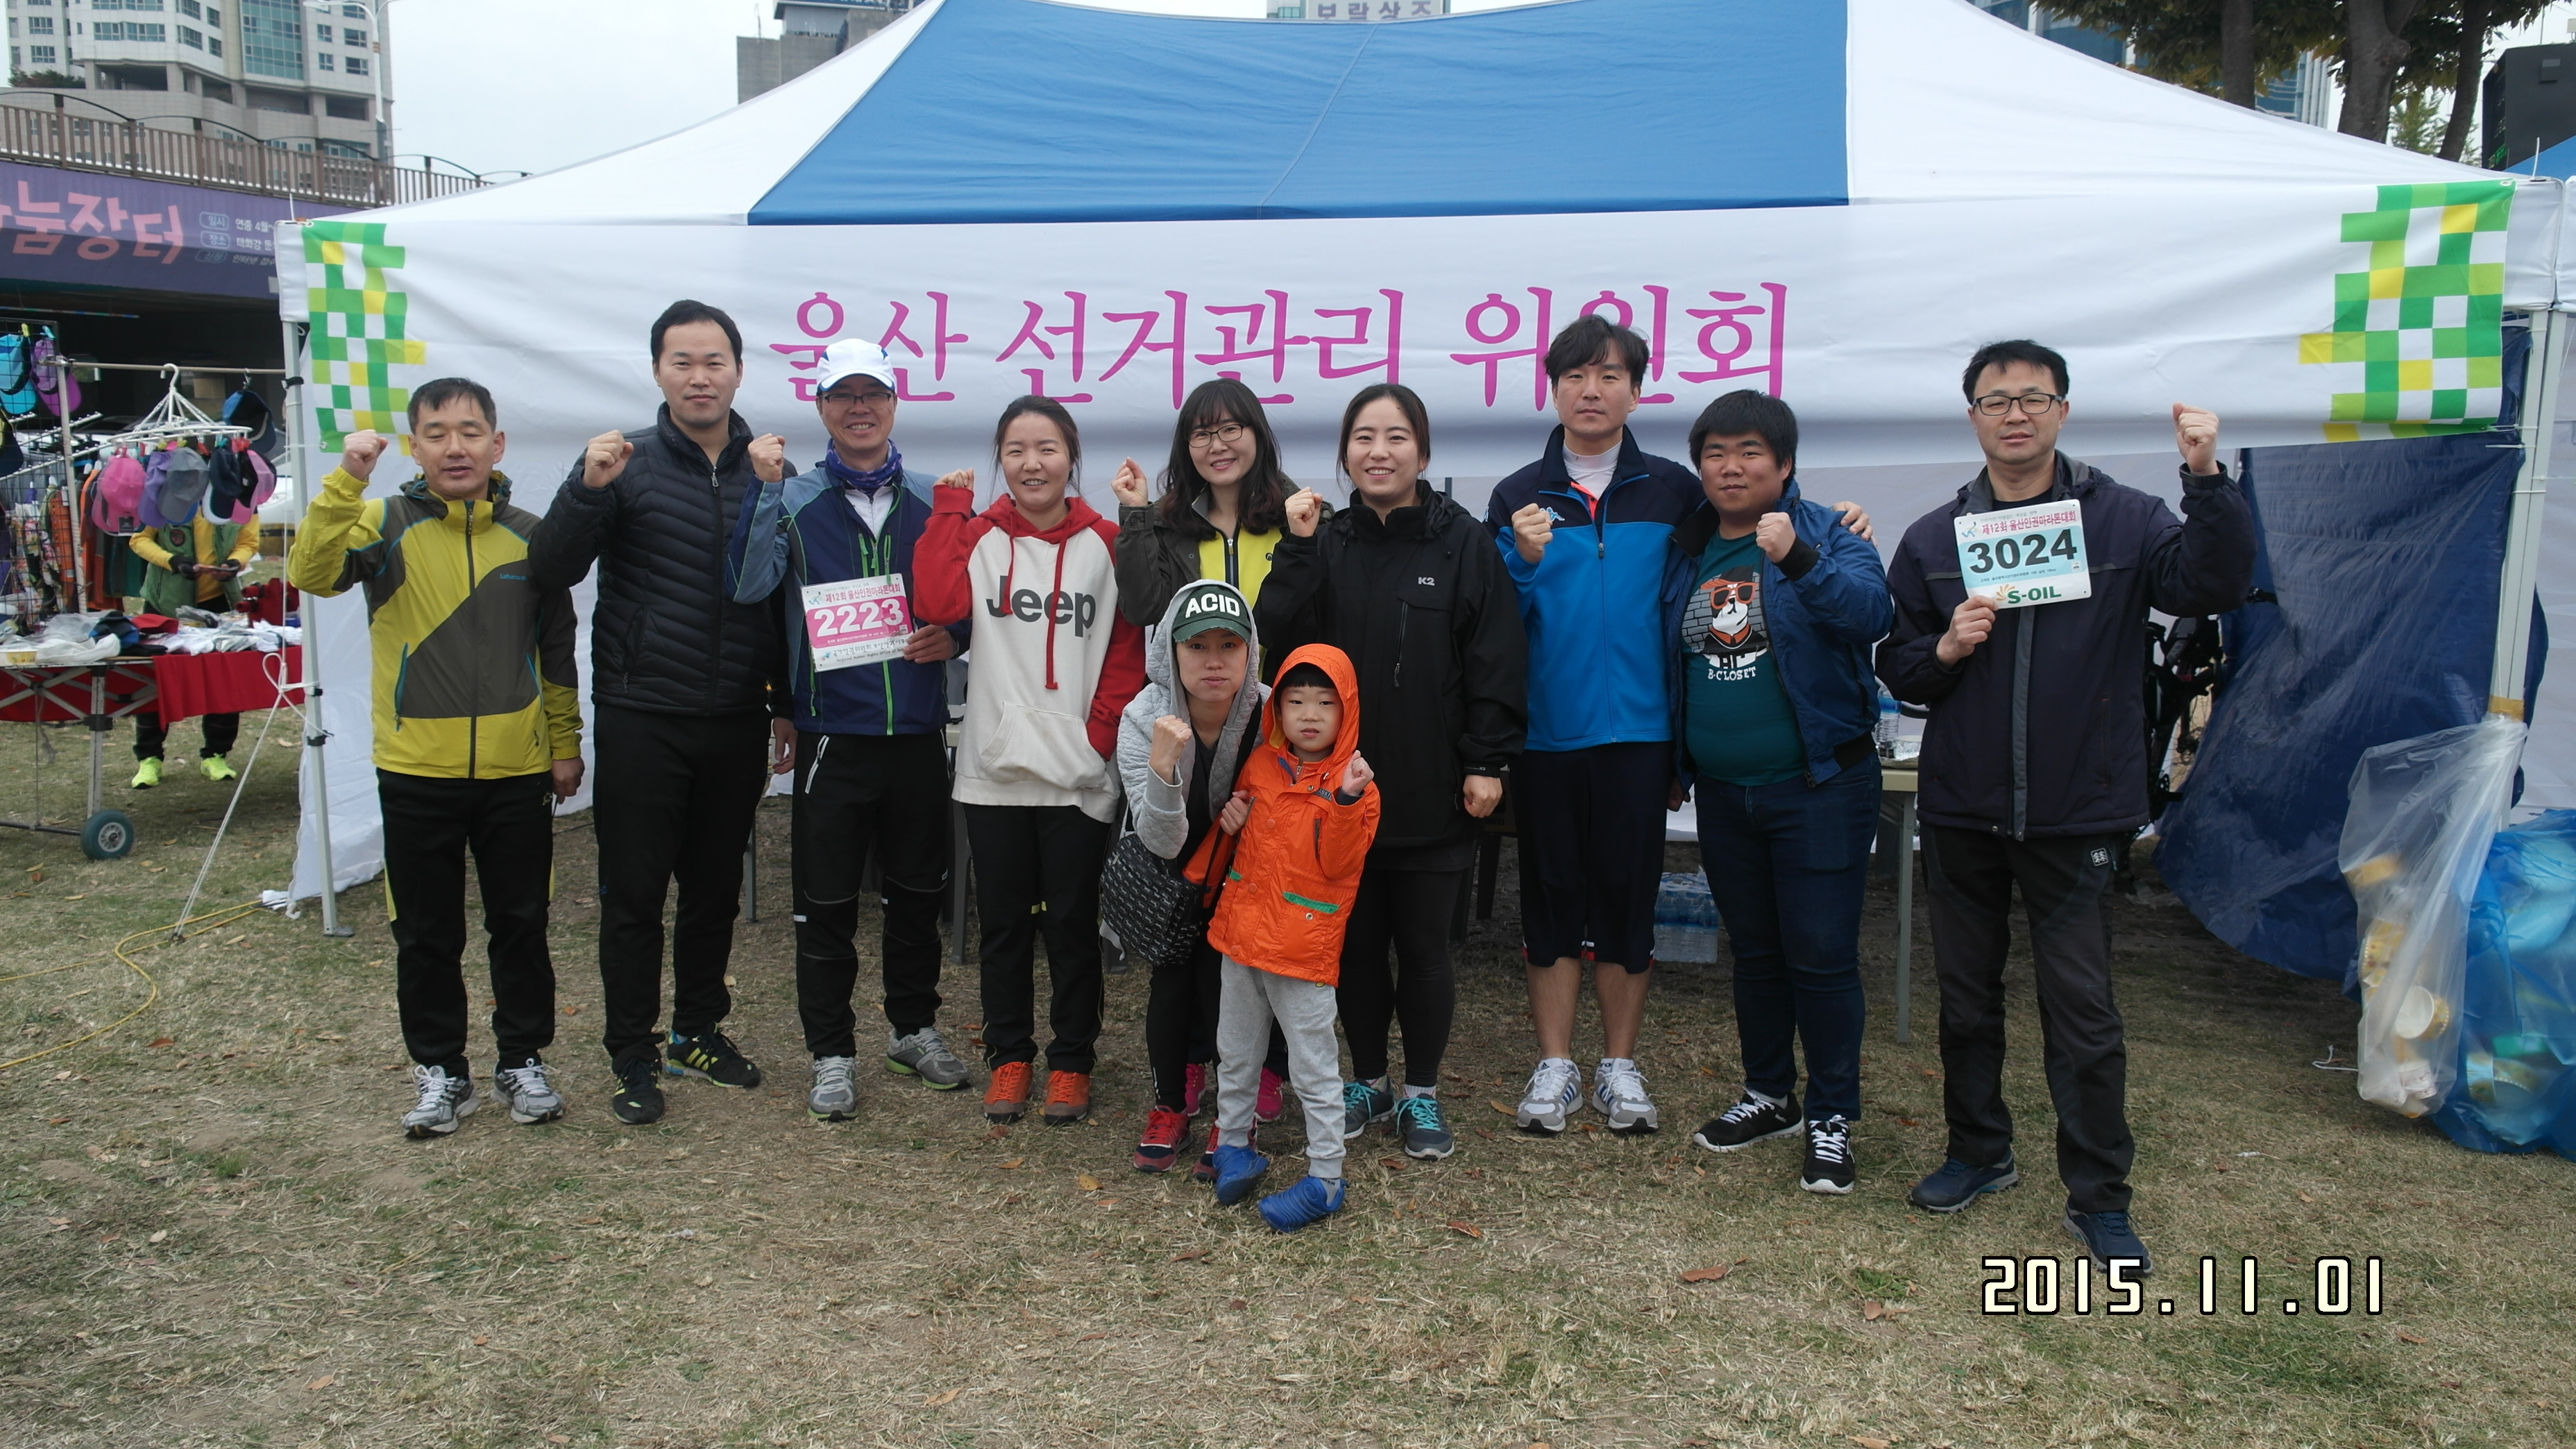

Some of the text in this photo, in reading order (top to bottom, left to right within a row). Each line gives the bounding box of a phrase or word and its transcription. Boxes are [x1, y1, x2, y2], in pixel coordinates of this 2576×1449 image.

[237, 237, 262, 251] 태화강
[769, 291, 969, 402] 울산
[995, 287, 1403, 411] 선거관리
[1982, 511, 2076, 534] 제12회 울산인권마라톤대회
[1967, 529, 2077, 573] 3024
[826, 591, 847, 603] 제12회
[847, 583, 901, 600] 울산인권마라톤대회
[1418, 577, 1435, 586] K2
[986, 575, 1096, 638] Jeep
[1185, 593, 1240, 618] ACID
[2007, 586, 2062, 604] S-OIL
[814, 598, 904, 637] 2223
